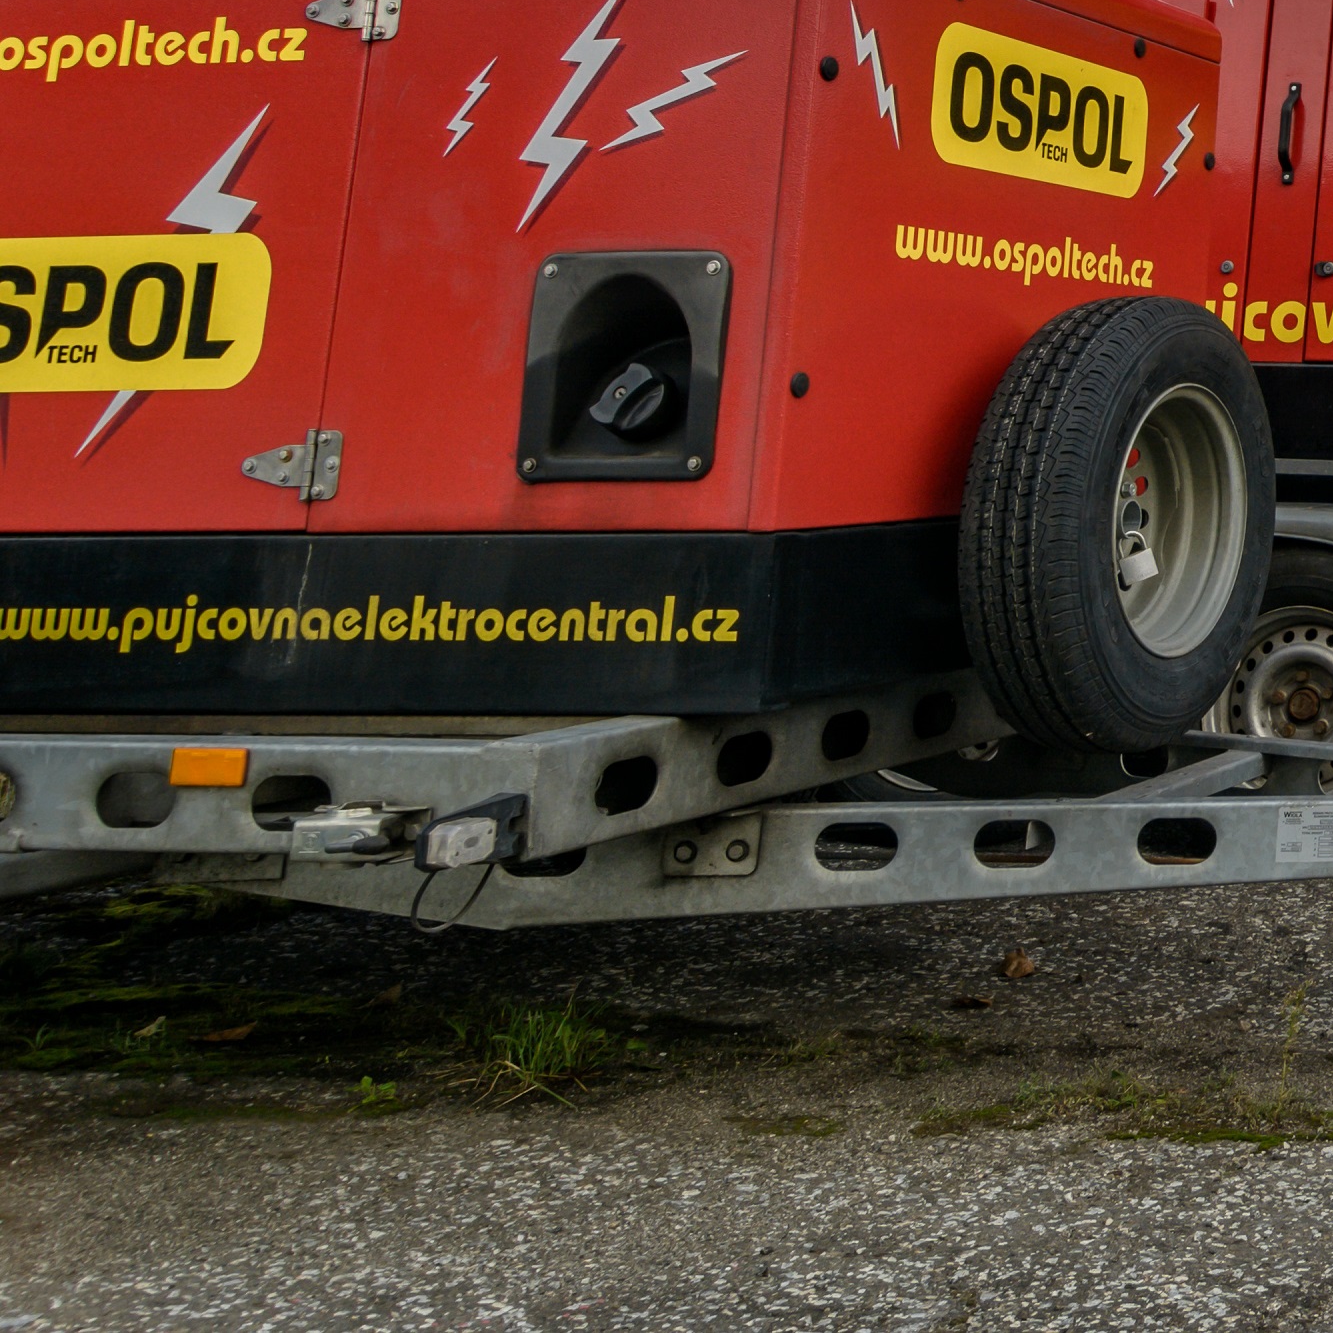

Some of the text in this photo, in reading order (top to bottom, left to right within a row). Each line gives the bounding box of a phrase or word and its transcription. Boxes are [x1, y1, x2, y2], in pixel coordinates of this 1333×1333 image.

[949, 51, 1133, 175] OSPOL
[1041, 142, 1068, 164] TECH
[895, 224, 1154, 289] www.ospoltech.cz
[47, 345, 97, 364] TECH
[0, 594, 740, 653] www.pujcovnaelektrocentral.cz
